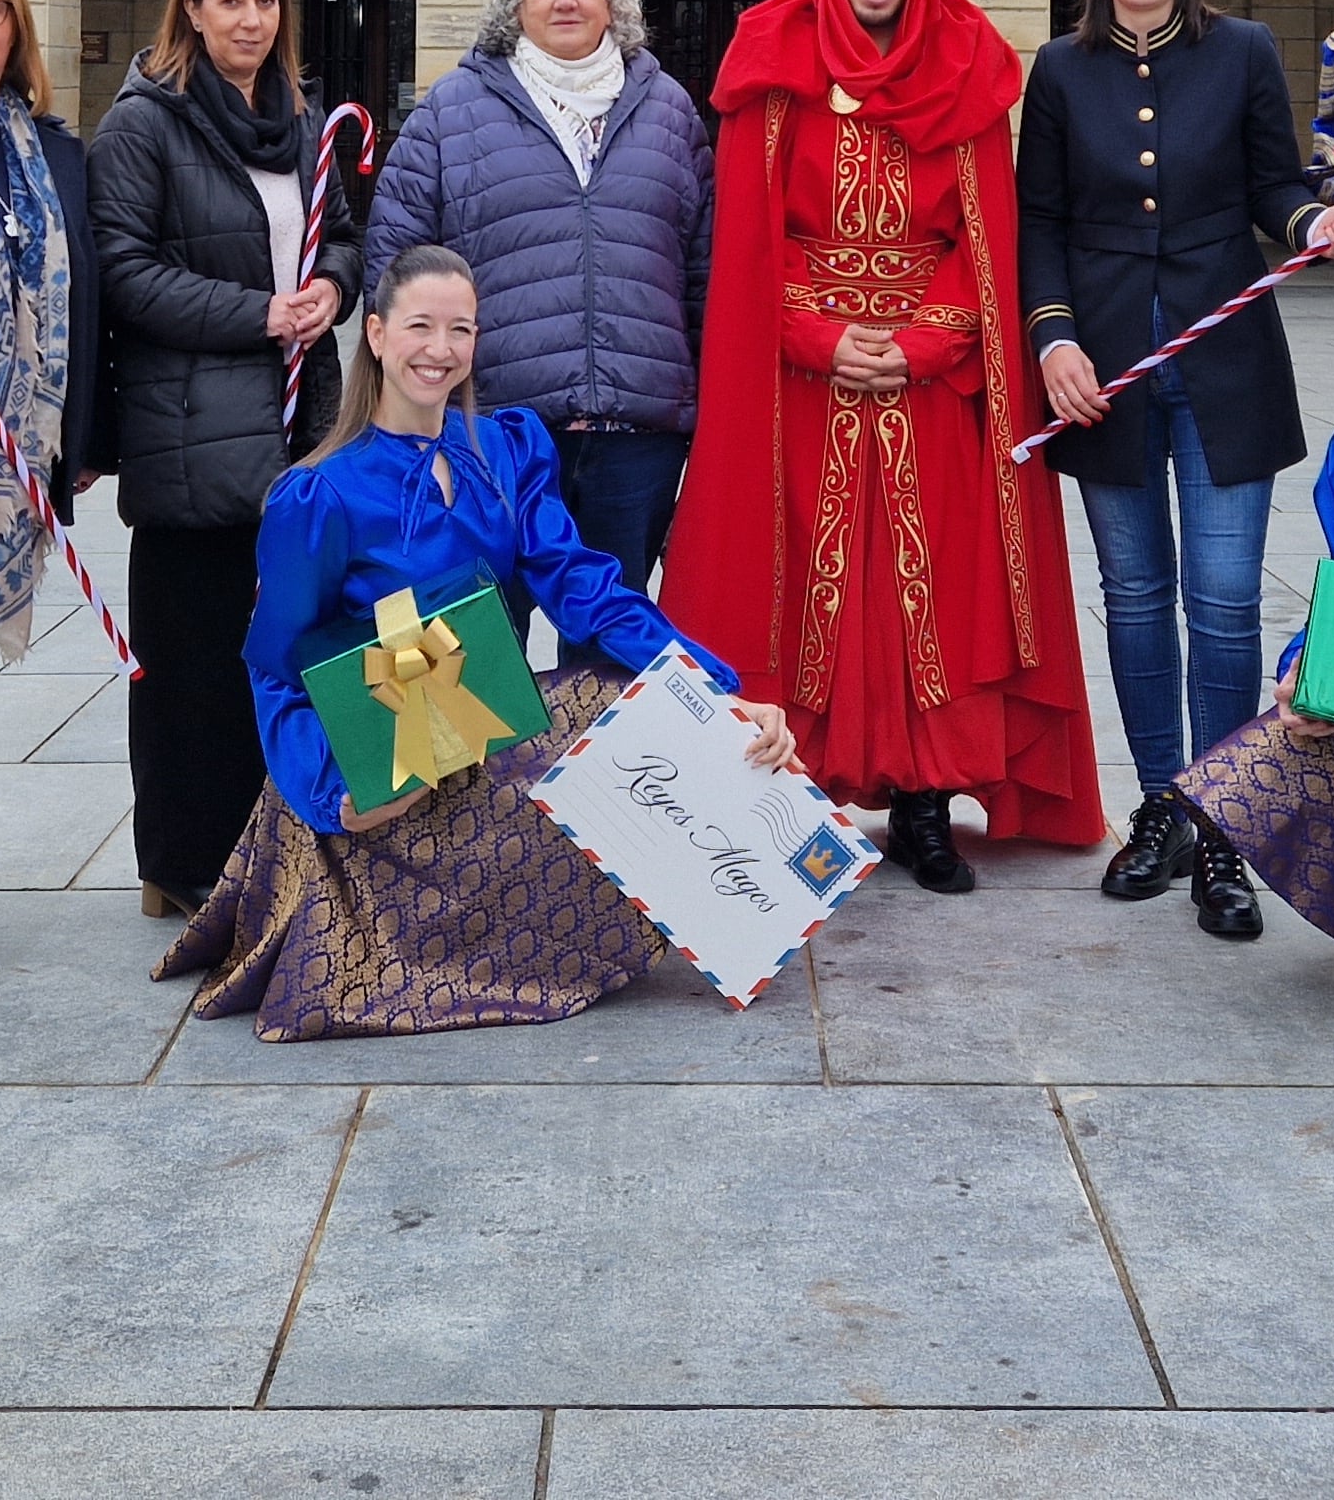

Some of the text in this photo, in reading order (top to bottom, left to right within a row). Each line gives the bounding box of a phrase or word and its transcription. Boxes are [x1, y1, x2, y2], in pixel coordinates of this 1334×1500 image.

[671, 680, 706, 718] 22 MAIL
[612, 755, 779, 913] Reyes Magos
